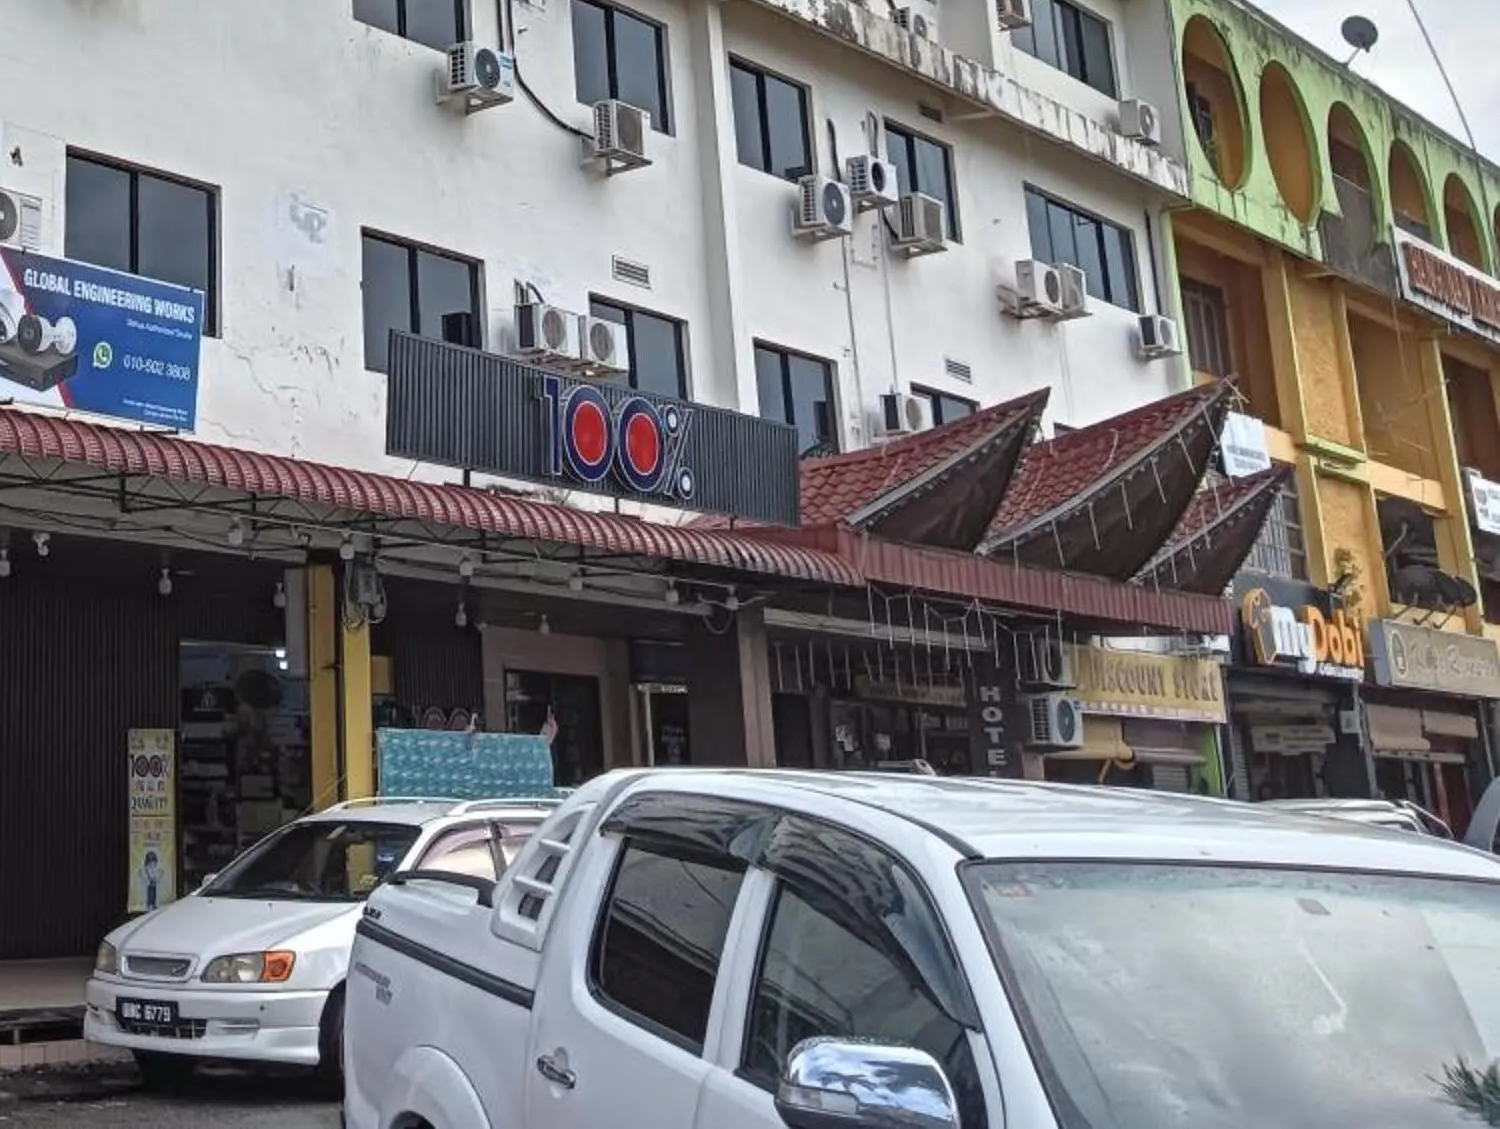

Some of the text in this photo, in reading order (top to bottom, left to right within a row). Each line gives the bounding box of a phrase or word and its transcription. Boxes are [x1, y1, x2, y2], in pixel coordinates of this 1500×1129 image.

[24, 268, 196, 324] GLOBAL ENGINEERING WORKS
[543, 374, 695, 501] 100%
[979, 685, 1007, 776] HOTE
